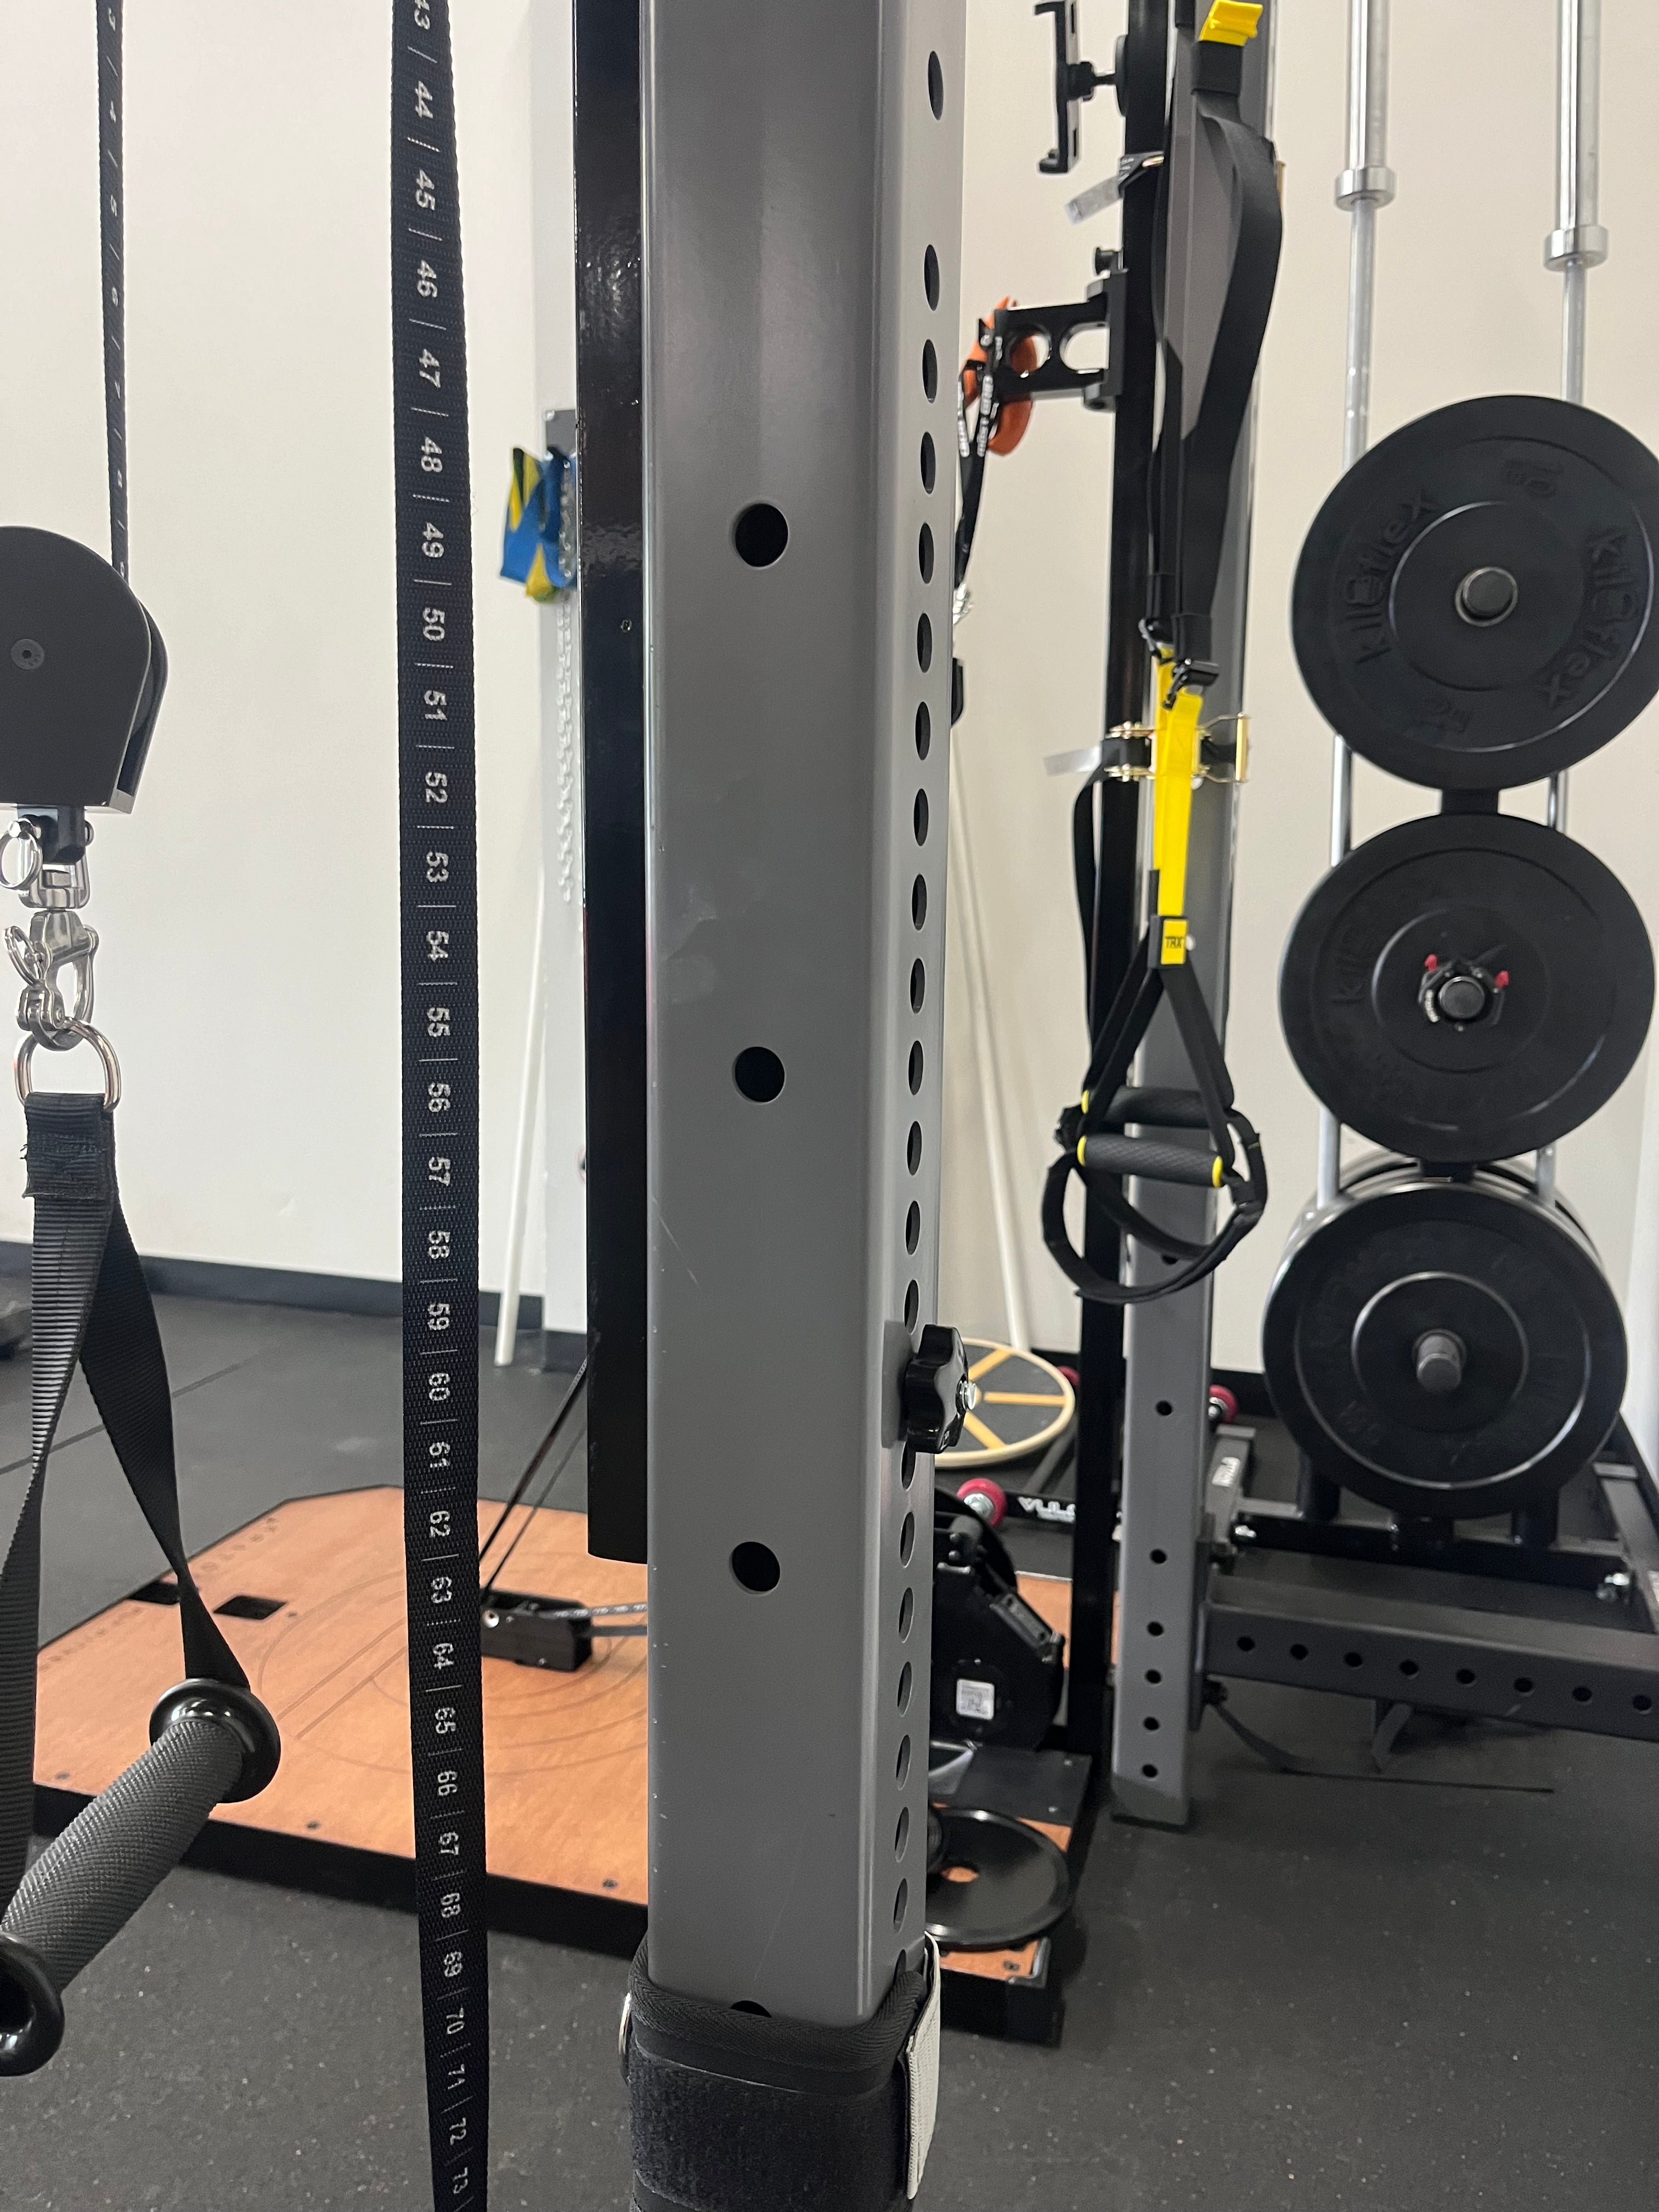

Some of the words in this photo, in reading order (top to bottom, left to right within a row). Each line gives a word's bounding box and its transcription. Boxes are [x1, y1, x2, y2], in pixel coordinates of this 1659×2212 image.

[415, 81, 433, 119] 44
[415, 170, 436, 211] 45
[417, 260, 438, 298] 46
[419, 348, 441, 388] 47
[421, 437, 443, 472] 48
[421, 522, 444, 558] 49
[422, 607, 445, 641] 50
[424, 690, 447, 720] 51
[425, 771, 448, 803] 52
[426, 851, 449, 883] 53
[426, 930, 449, 961] 54
[1165, 935, 1184, 949] TRX
[427, 1007, 450, 1037] 55
[428, 1082, 451, 1113] 56
[428, 1156, 451, 1187] 57
[428, 1231, 450, 1260] 58
[427, 1303, 450, 1331] 59
[428, 1373, 450, 1401] 60
[429, 1441, 450, 1468] 61
[430, 1510, 451, 1537] 62
[431, 1576, 453, 1604] 63
[433, 1643, 454, 1670] 64
[435, 1707, 456, 1734] 65
[437, 1770, 458, 1796] 66
[438, 1831, 459, 1855] 67
[441, 1892, 461, 1918] 68
[443, 1951, 463, 1977] 69
[446, 2007, 465, 2035] 70
[447, 2063, 465, 2090] 71
[449, 2117, 467, 2145] 72
[453, 2166, 469, 2194] 73
